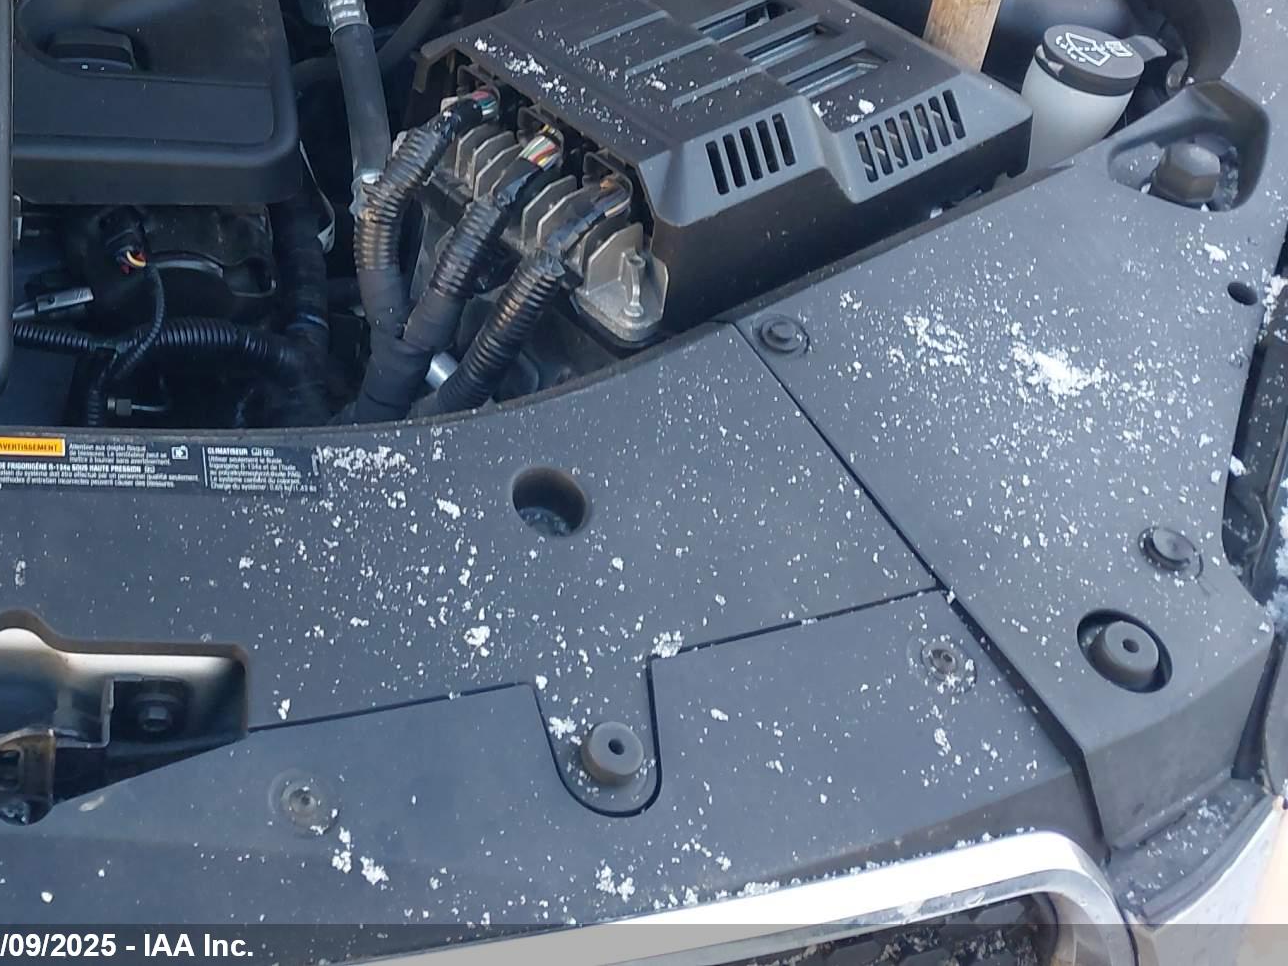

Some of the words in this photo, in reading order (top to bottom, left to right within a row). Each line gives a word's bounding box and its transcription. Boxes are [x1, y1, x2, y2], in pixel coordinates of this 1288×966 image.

[207, 447, 248, 456] CLIMATISEUR
[48, 463, 70, 471] R-134a
[72, 464, 88, 472] SOUS
[89, 464, 110, 472] HAUTE
[110, 465, 141, 473] PRESSION
